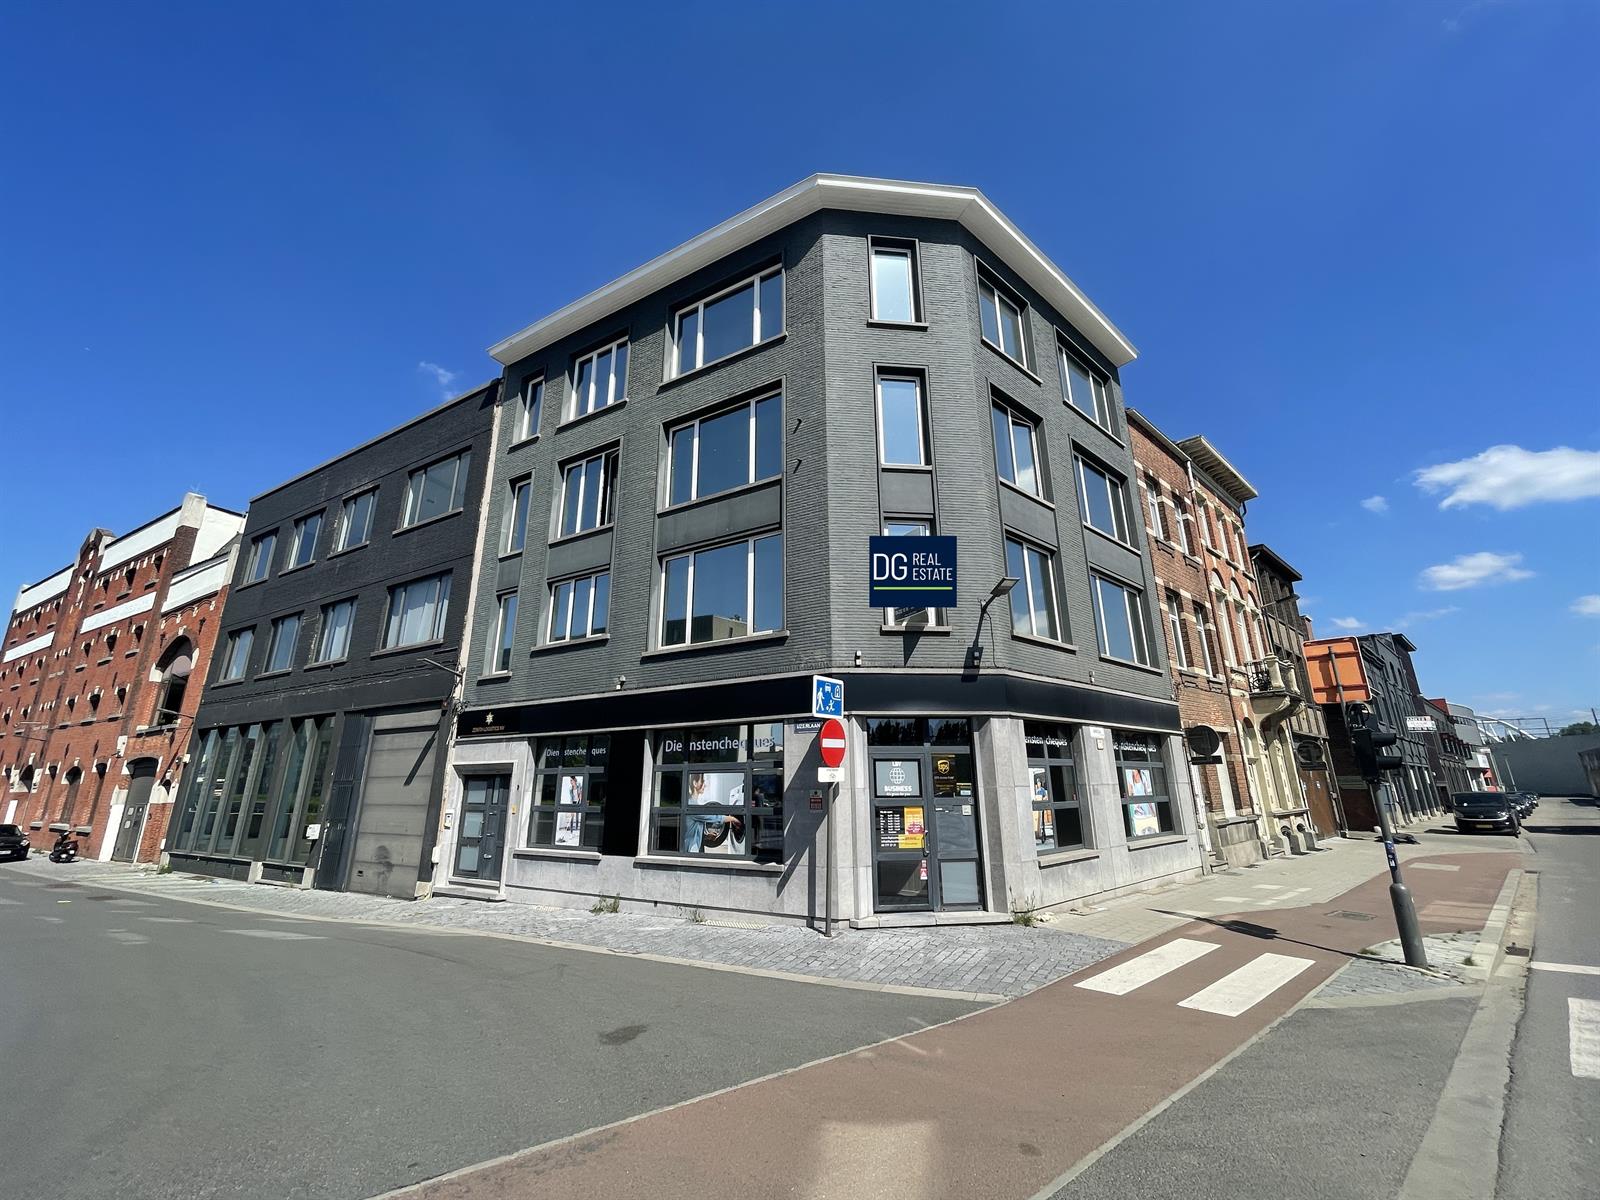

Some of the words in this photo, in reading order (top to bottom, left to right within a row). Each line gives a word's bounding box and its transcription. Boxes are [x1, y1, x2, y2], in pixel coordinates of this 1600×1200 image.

[912, 553, 941, 566] REAL
[873, 553, 908, 581] DG
[912, 567, 953, 581] ESTATE
